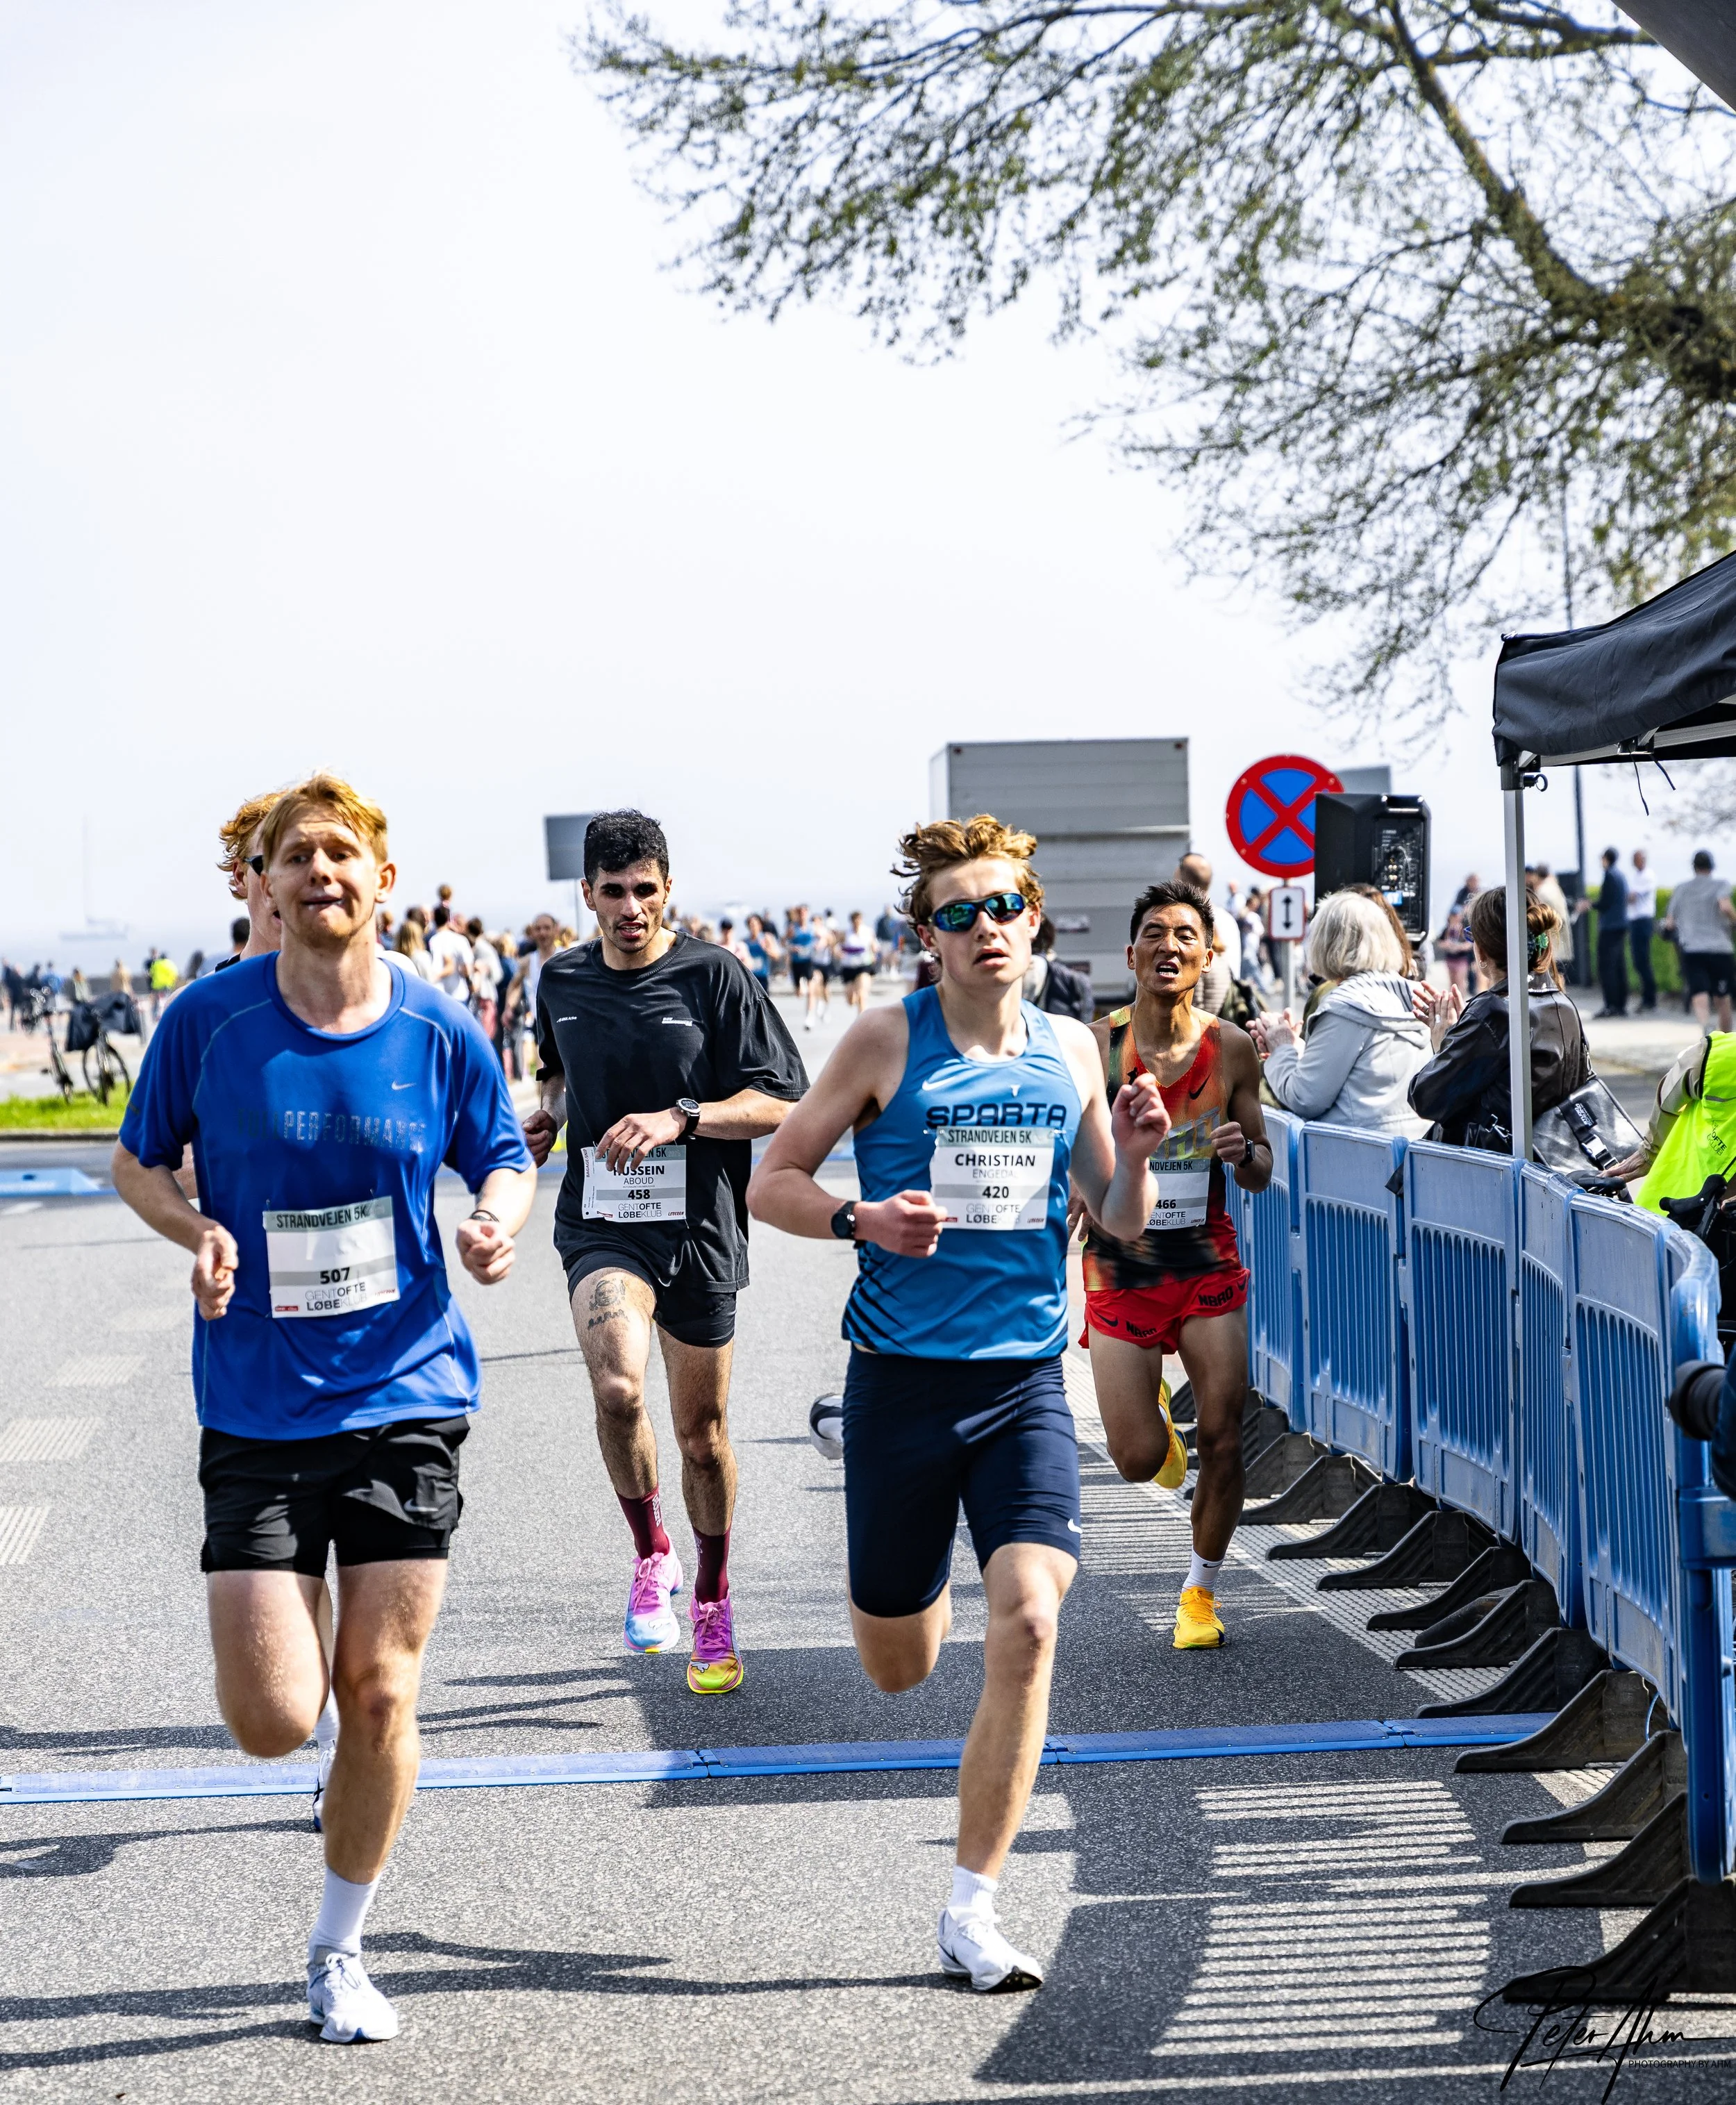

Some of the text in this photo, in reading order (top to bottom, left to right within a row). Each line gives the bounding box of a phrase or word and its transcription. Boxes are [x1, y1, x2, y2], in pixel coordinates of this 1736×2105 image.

[925, 1102, 1067, 1130] SPARTA
[948, 1129, 1032, 1144] STRANDVEJEN 5K
[656, 1147, 667, 1158] 5K
[955, 1154, 1036, 1167] CHRISTIAN
[1183, 1161, 1193, 1171] 5K
[624, 1176, 654, 1185] ABOUD
[627, 1189, 651, 1200] 458
[982, 1185, 1010, 1199] 420
[618, 1202, 662, 1211] GENTOFTE
[1155, 1199, 1176, 1209] 466
[276, 1205, 368, 1229] STRANDVEJEN 5K
[618, 1210, 662, 1219] LØBEKLUB
[1150, 1211, 1186, 1220] ENTOFTE
[319, 1267, 351, 1284] 507
[305, 1282, 366, 1301] GENTOFTE
[1198, 1286, 1234, 1307] NBRO
